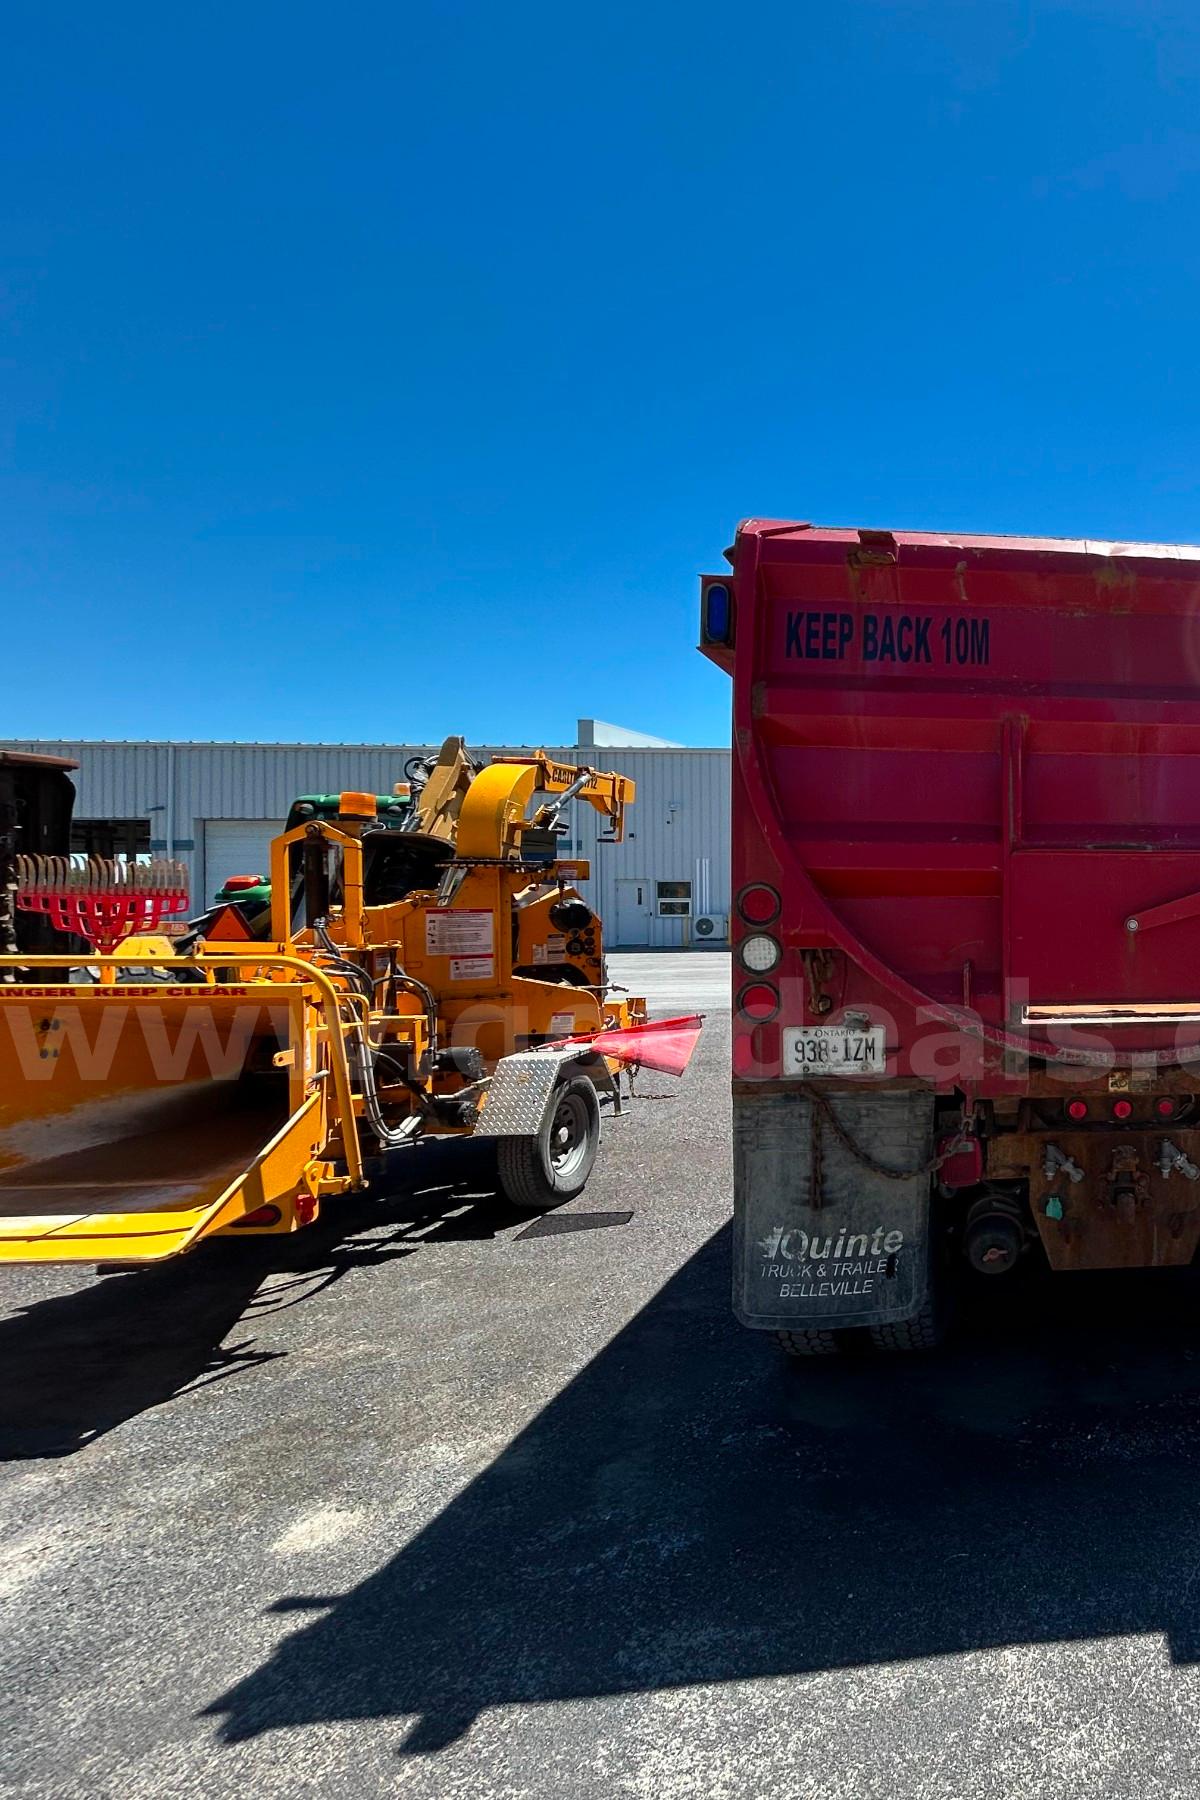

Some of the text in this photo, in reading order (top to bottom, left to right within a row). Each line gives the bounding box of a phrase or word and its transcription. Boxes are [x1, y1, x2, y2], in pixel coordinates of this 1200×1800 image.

[785, 611, 990, 665] KEEP BACK 10M
[94, 988, 158, 997] KEEP
[166, 987, 248, 996] CLEAR
[814, 1029, 855, 1038] ONTARIO
[780, 1225, 904, 1262] Quinte
[816, 1263, 826, 1277] &
[779, 1279, 874, 1298] BELLEVILLE
